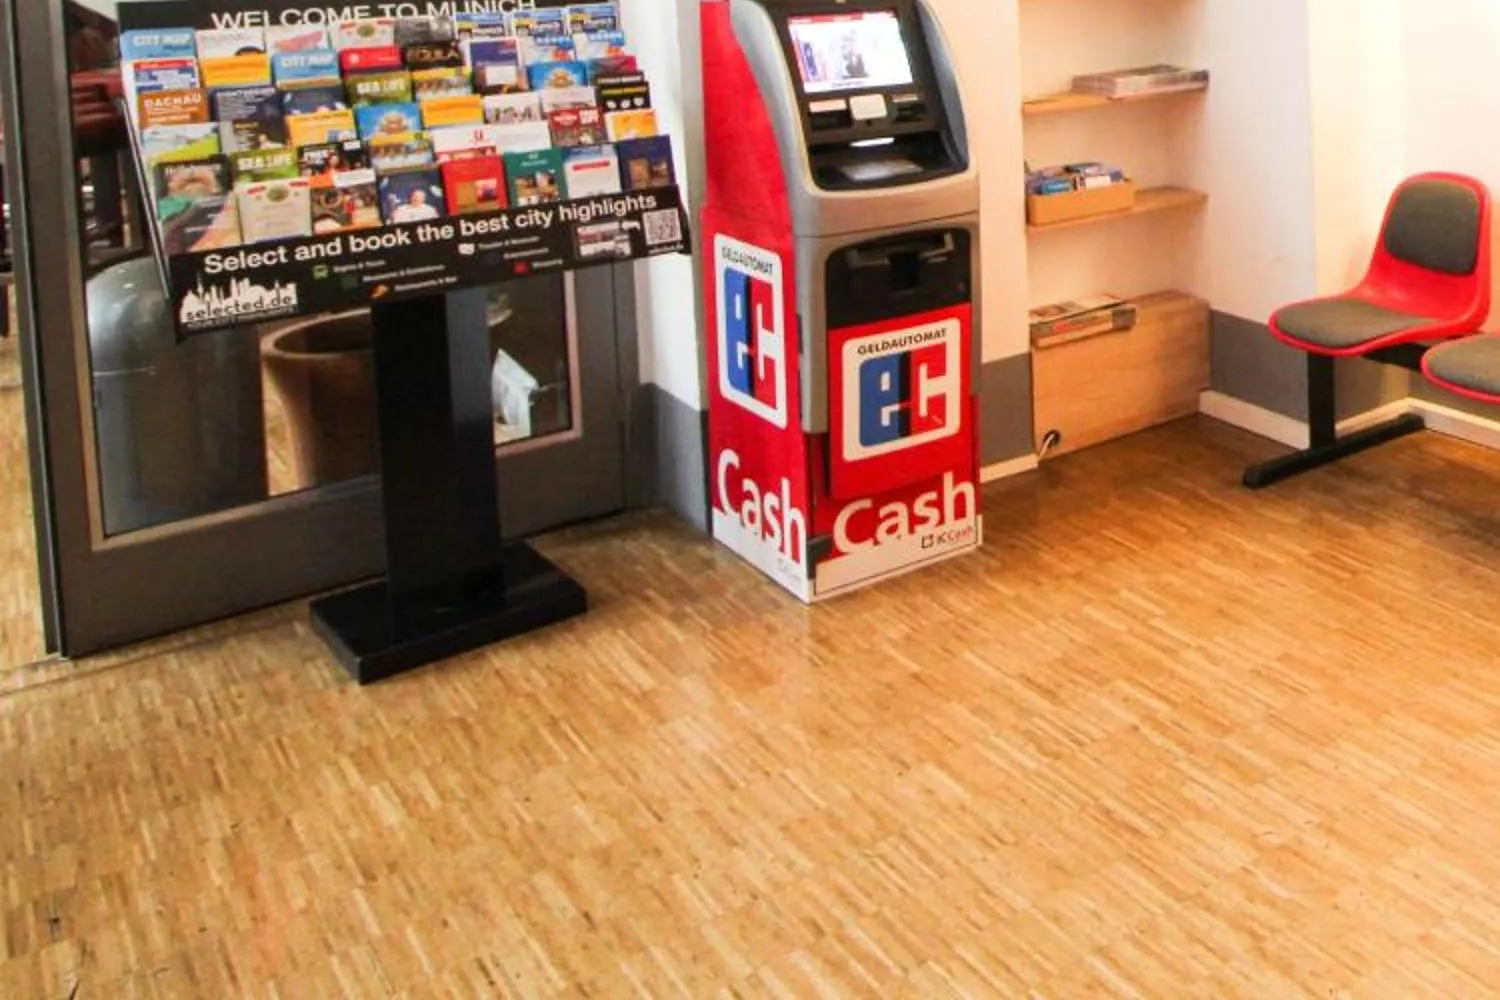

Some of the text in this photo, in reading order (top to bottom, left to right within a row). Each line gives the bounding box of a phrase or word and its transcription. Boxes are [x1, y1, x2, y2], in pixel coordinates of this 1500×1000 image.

[211, 4, 371, 31] WELCOME
[377, 2, 413, 18] TO
[204, 249, 288, 273] Select
[295, 238, 342, 261] and
[350, 229, 411, 252] book
[417, 223, 454, 243] the
[460, 217, 510, 237] best
[515, 208, 554, 229] city
[559, 194, 657, 222] highlights
[186, 289, 293, 320] selected.de
[857, 328, 948, 356] GELDAUTOMAT
[717, 449, 806, 565] Cash
[833, 472, 976, 555] Cash
